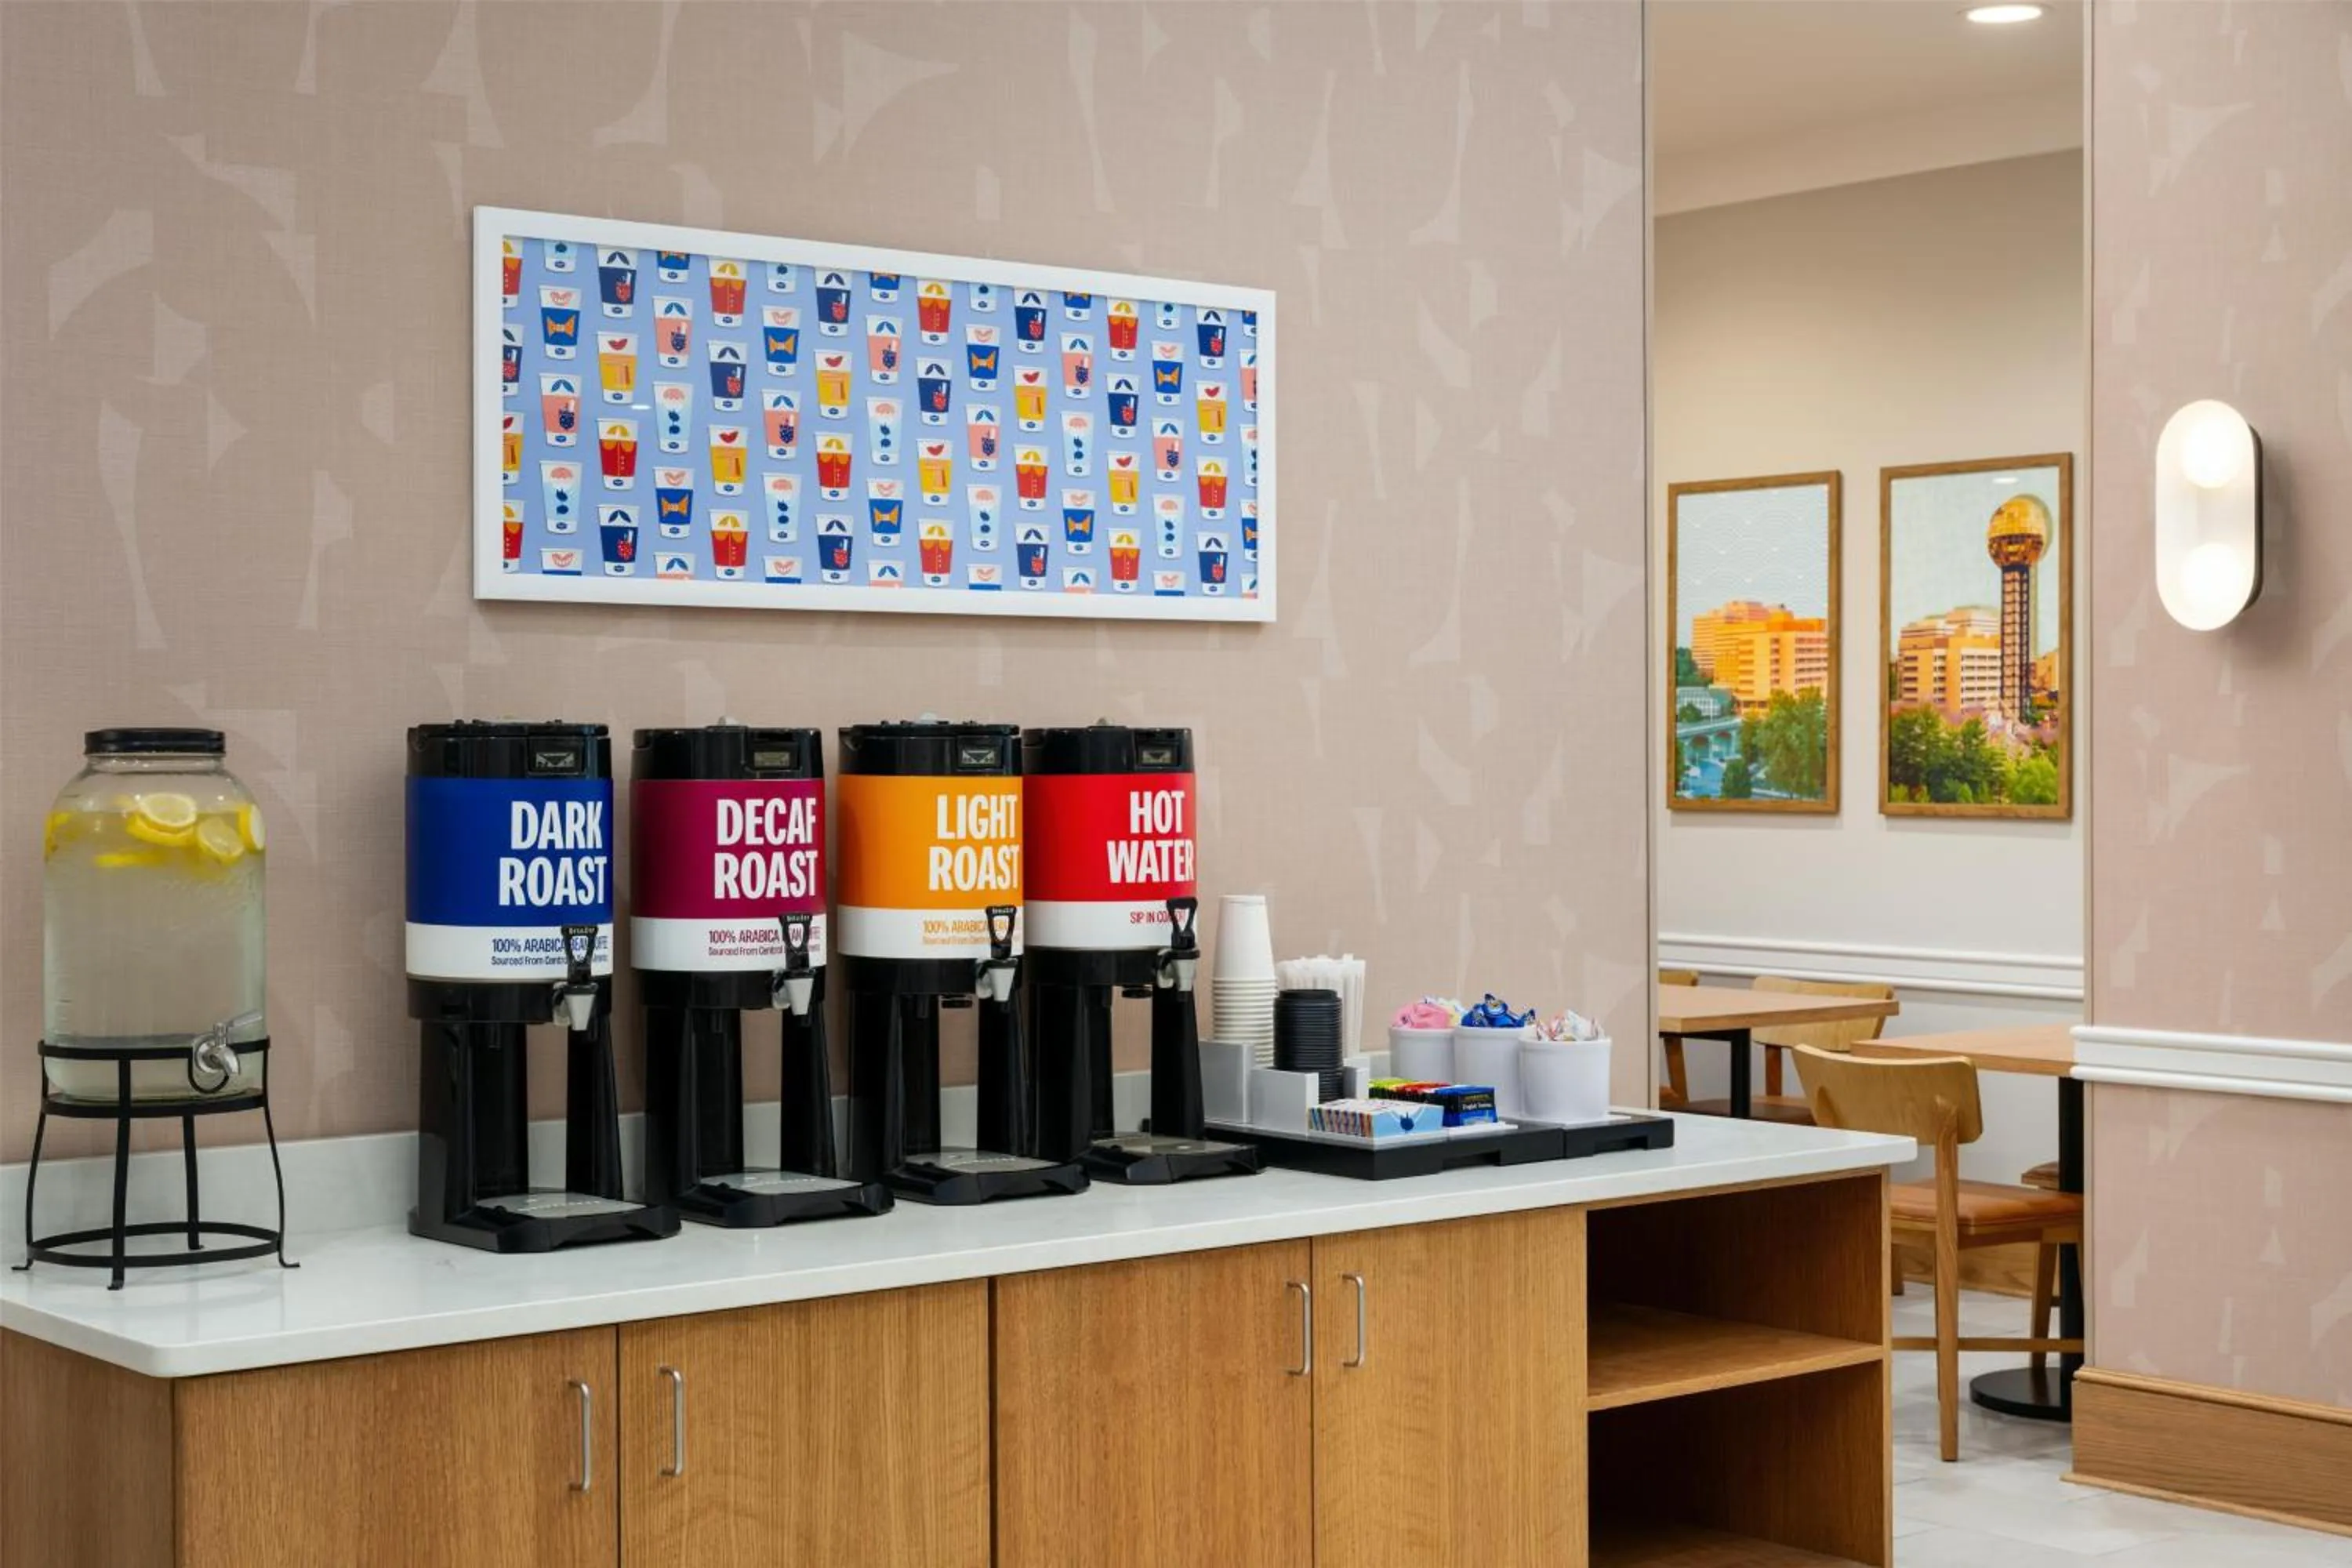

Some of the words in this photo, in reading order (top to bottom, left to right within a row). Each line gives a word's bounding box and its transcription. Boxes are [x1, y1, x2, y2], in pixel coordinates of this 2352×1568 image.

[510, 800, 603, 850] DARK
[717, 797, 817, 846] DECAF
[936, 793, 1018, 840] LIGHT
[1130, 789, 1185, 835] HOT
[498, 855, 608, 906] ROAST
[713, 849, 818, 899] ROAST
[928, 844, 1020, 891] ROAST
[1106, 839, 1194, 884] WATER
[709, 929, 736, 943] 100%
[739, 928, 780, 943] ARABICA
[1130, 910, 1145, 924] SIP
[1146, 910, 1155, 923] IN
[492, 938, 521, 953] 100%
[523, 937, 565, 953] ARABICA
[524, 955, 543, 965] From
